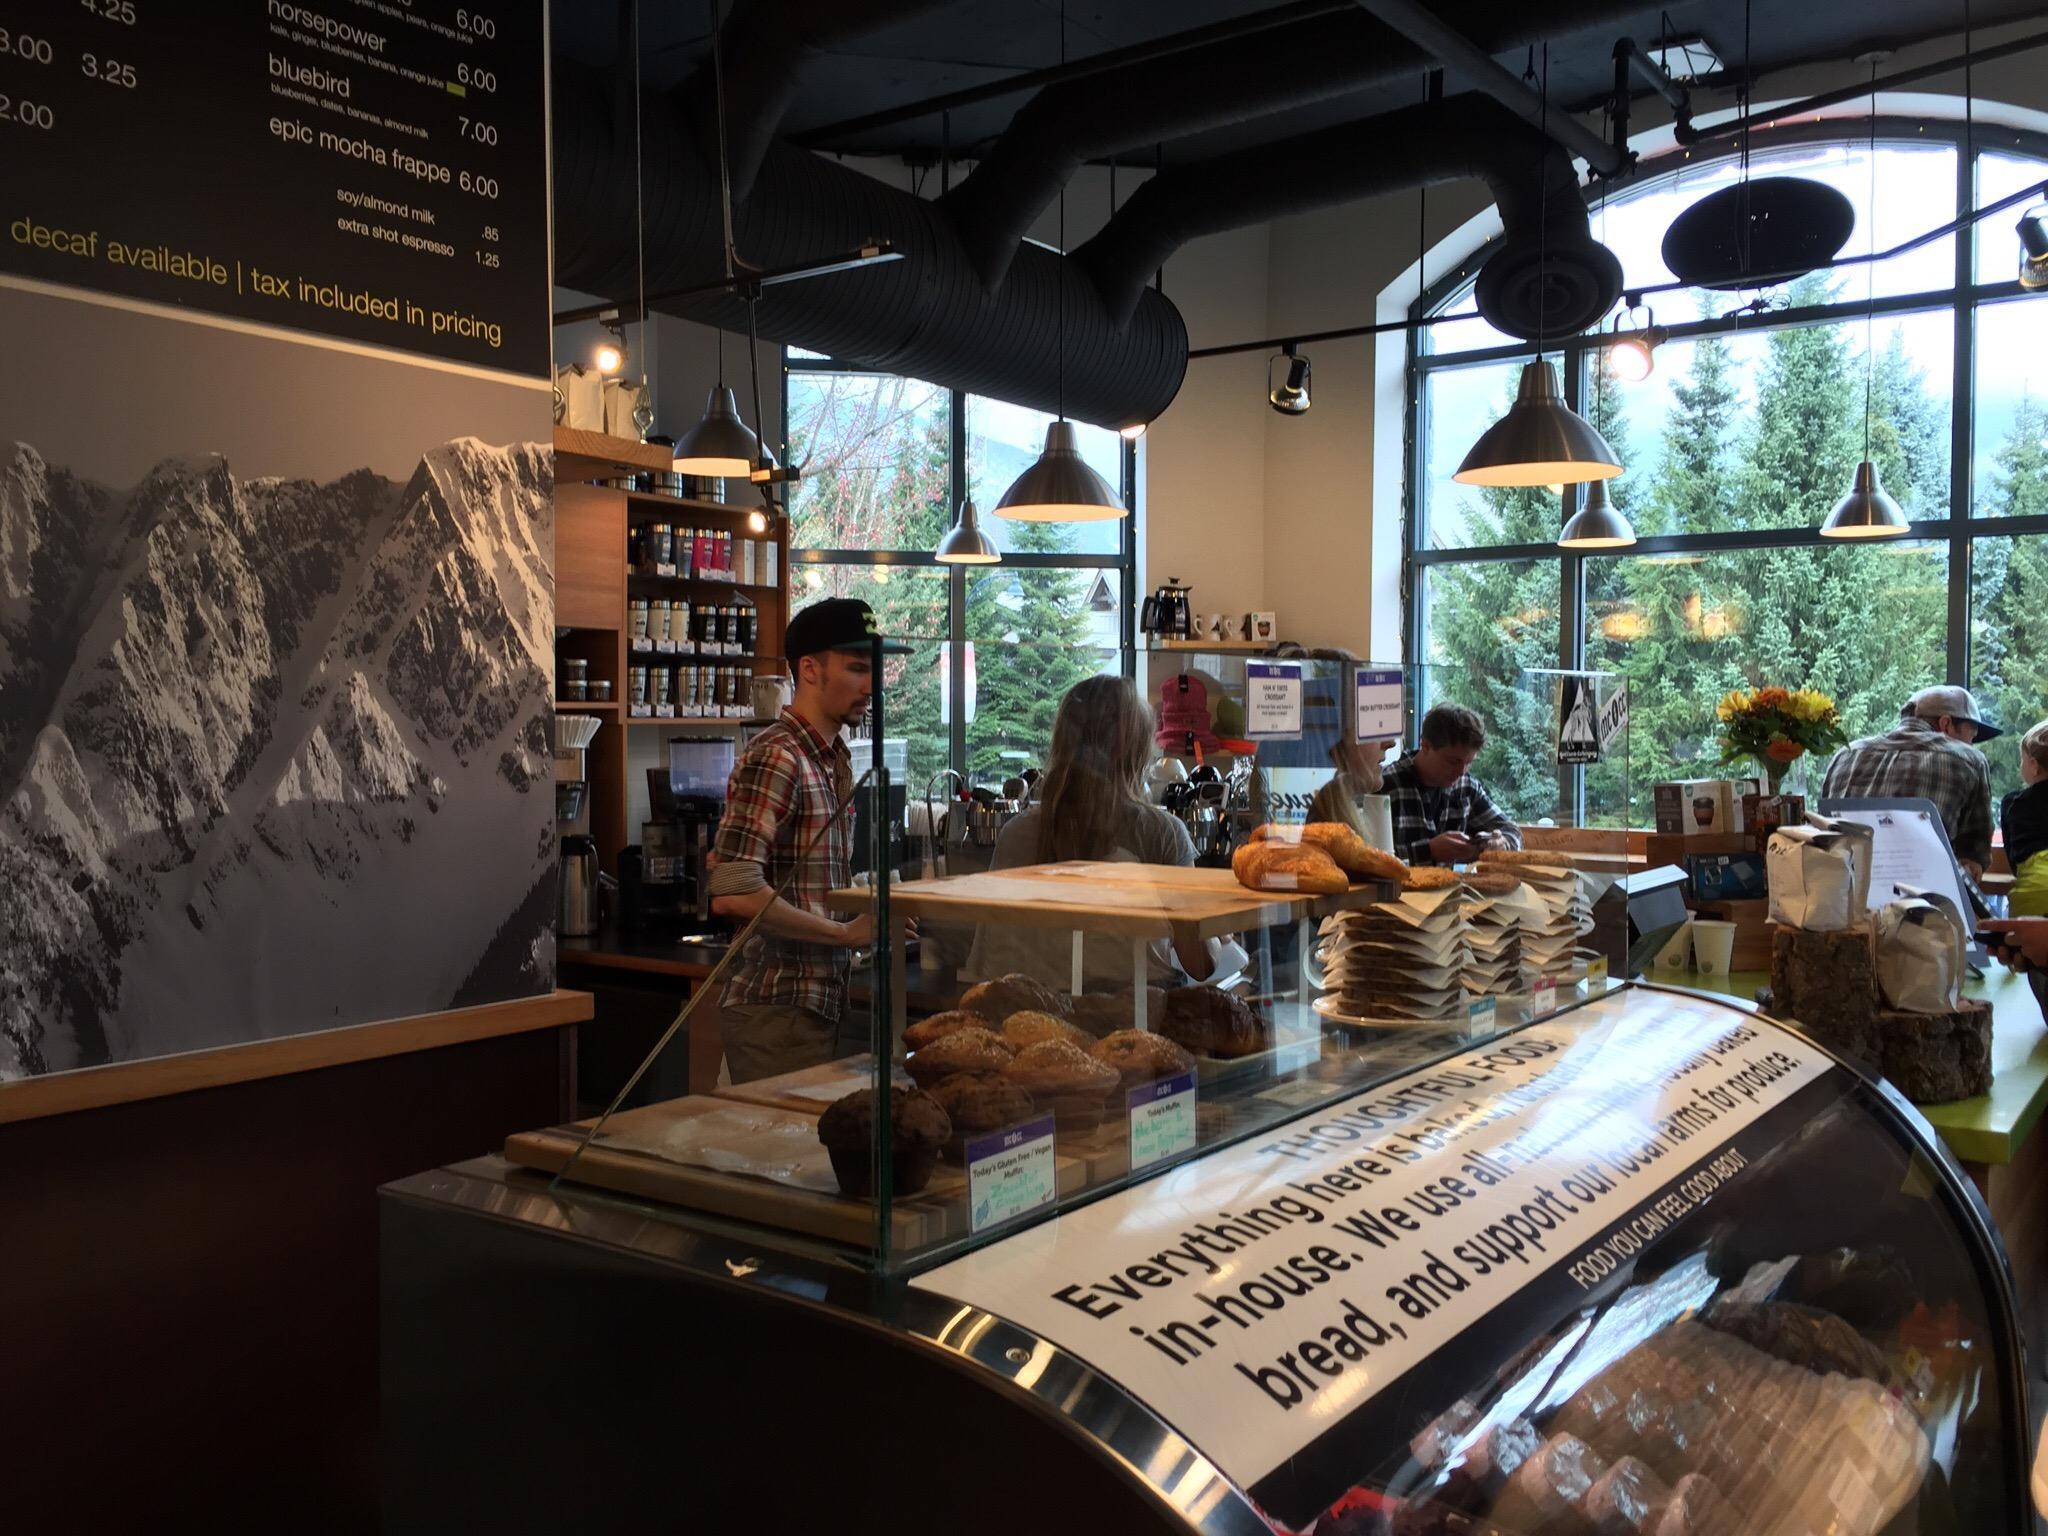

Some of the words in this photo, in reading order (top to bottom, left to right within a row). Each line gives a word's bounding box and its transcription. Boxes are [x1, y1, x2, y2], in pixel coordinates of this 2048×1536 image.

[268, 0, 387, 53] horsepower
[457, 62, 497, 93] 6.00
[456, 8, 496, 40] 6.00
[82, 53, 137, 89] 3.25
[269, 52, 350, 98] bluebird
[458, 116, 498, 146] 7.00
[269, 116, 313, 145] epic
[319, 130, 387, 166] mocha
[392, 149, 451, 183] frappe
[459, 170, 499, 199] 6.00
[337, 187, 408, 218] soy/almond
[411, 208, 435, 225] milk
[481, 226, 499, 242] .85
[337, 216, 369, 236] extra
[372, 226, 399, 244] shot
[402, 233, 455, 257] espresso
[475, 251, 500, 268] 1.25
[11, 217, 98, 257] decaf
[107, 241, 228, 285] available
[251, 268, 291, 299] tax
[299, 276, 399, 321] included
[406, 300, 425, 327] in
[432, 309, 501, 348] pricing
[1257, 1071, 1492, 1160] THOUGHTFUL
[1466, 1040, 1566, 1072] FOOD:
[972, 1162, 997, 1179] Today's
[997, 1157, 1018, 1173] Gluten
[1034, 1143, 1052, 1158] Vegan
[1050, 1194, 1313, 1319] Everything
[1285, 1158, 1394, 1203] here
[1363, 1143, 1424, 1164] is
[1236, 1298, 1406, 1409] bread,
[1381, 1249, 1472, 1319] and
[1449, 1185, 1581, 1275] support
[1557, 1164, 1619, 1201] our
[1588, 1126, 1670, 1177] local
[1690, 1085, 1742, 1113] for
[1723, 1050, 1802, 1103] produce.
[1568, 1247, 1617, 1290] FOOD
[1604, 1226, 1643, 1260] YOU
[1632, 1209, 1669, 1240] CAN
[1655, 1191, 1693, 1223] FEEL
[1680, 1170, 1720, 1203] GOOD
[1709, 1147, 1749, 1183] ABOUT
[1127, 1242, 1366, 1365] in-house.
[1330, 1205, 1426, 1248] We
[1400, 1175, 1483, 1216] use
